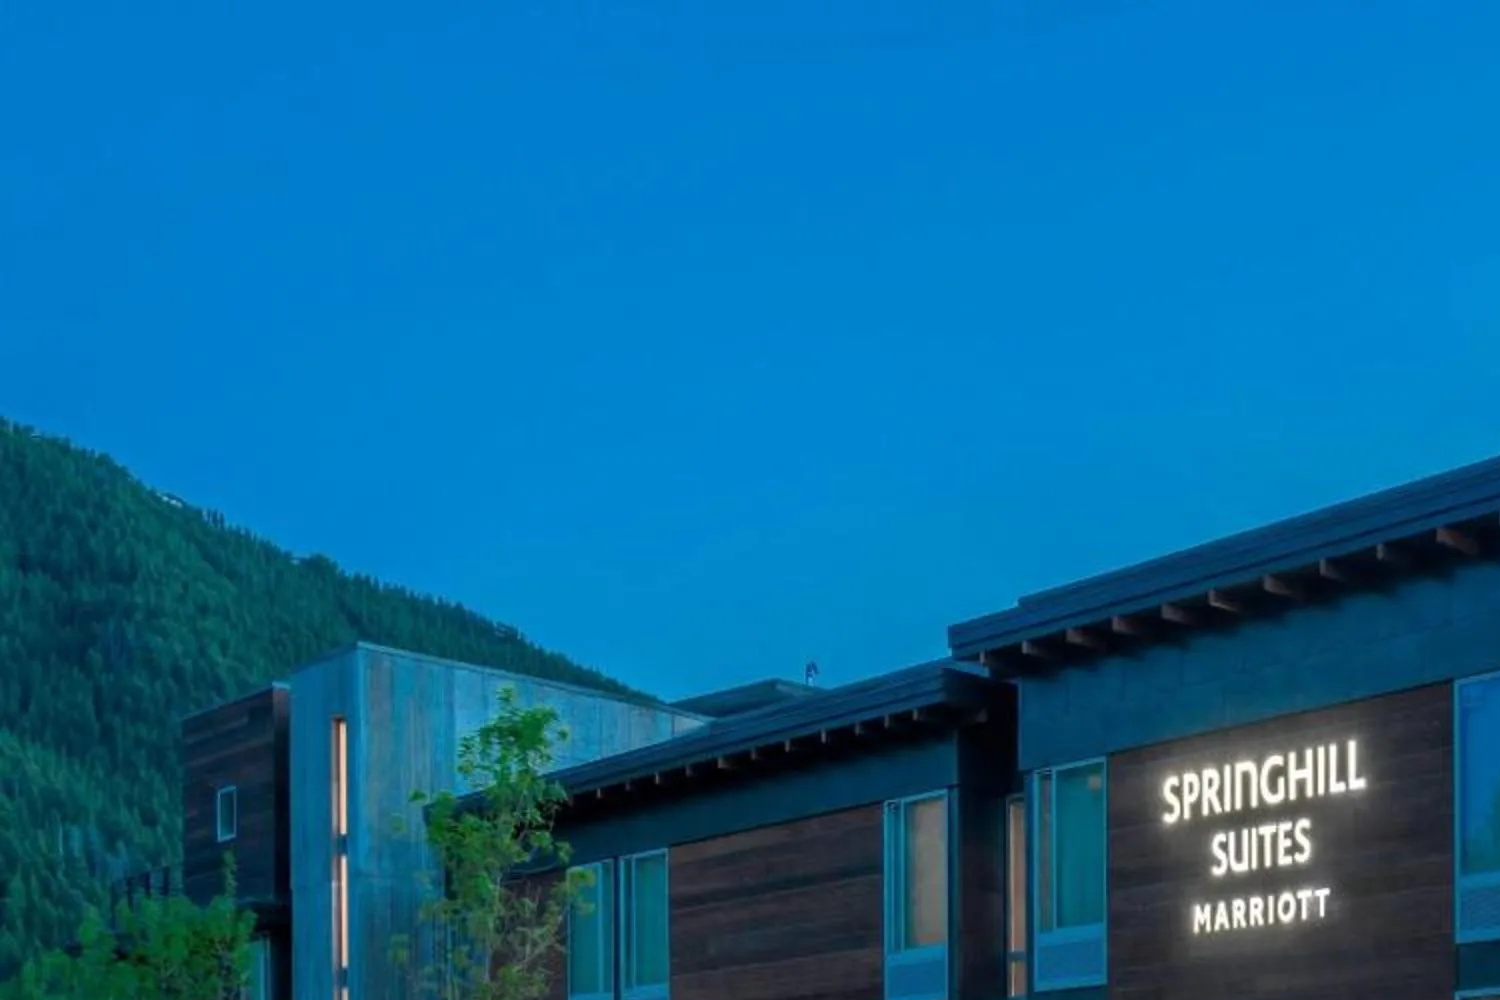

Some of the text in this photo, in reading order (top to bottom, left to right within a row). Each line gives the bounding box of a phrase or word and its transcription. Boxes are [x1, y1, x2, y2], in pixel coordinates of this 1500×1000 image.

[1162, 740, 1366, 824] SPRINGHILL
[1211, 818, 1311, 876] SUITES
[1193, 887, 1330, 934] MARRIOTT
